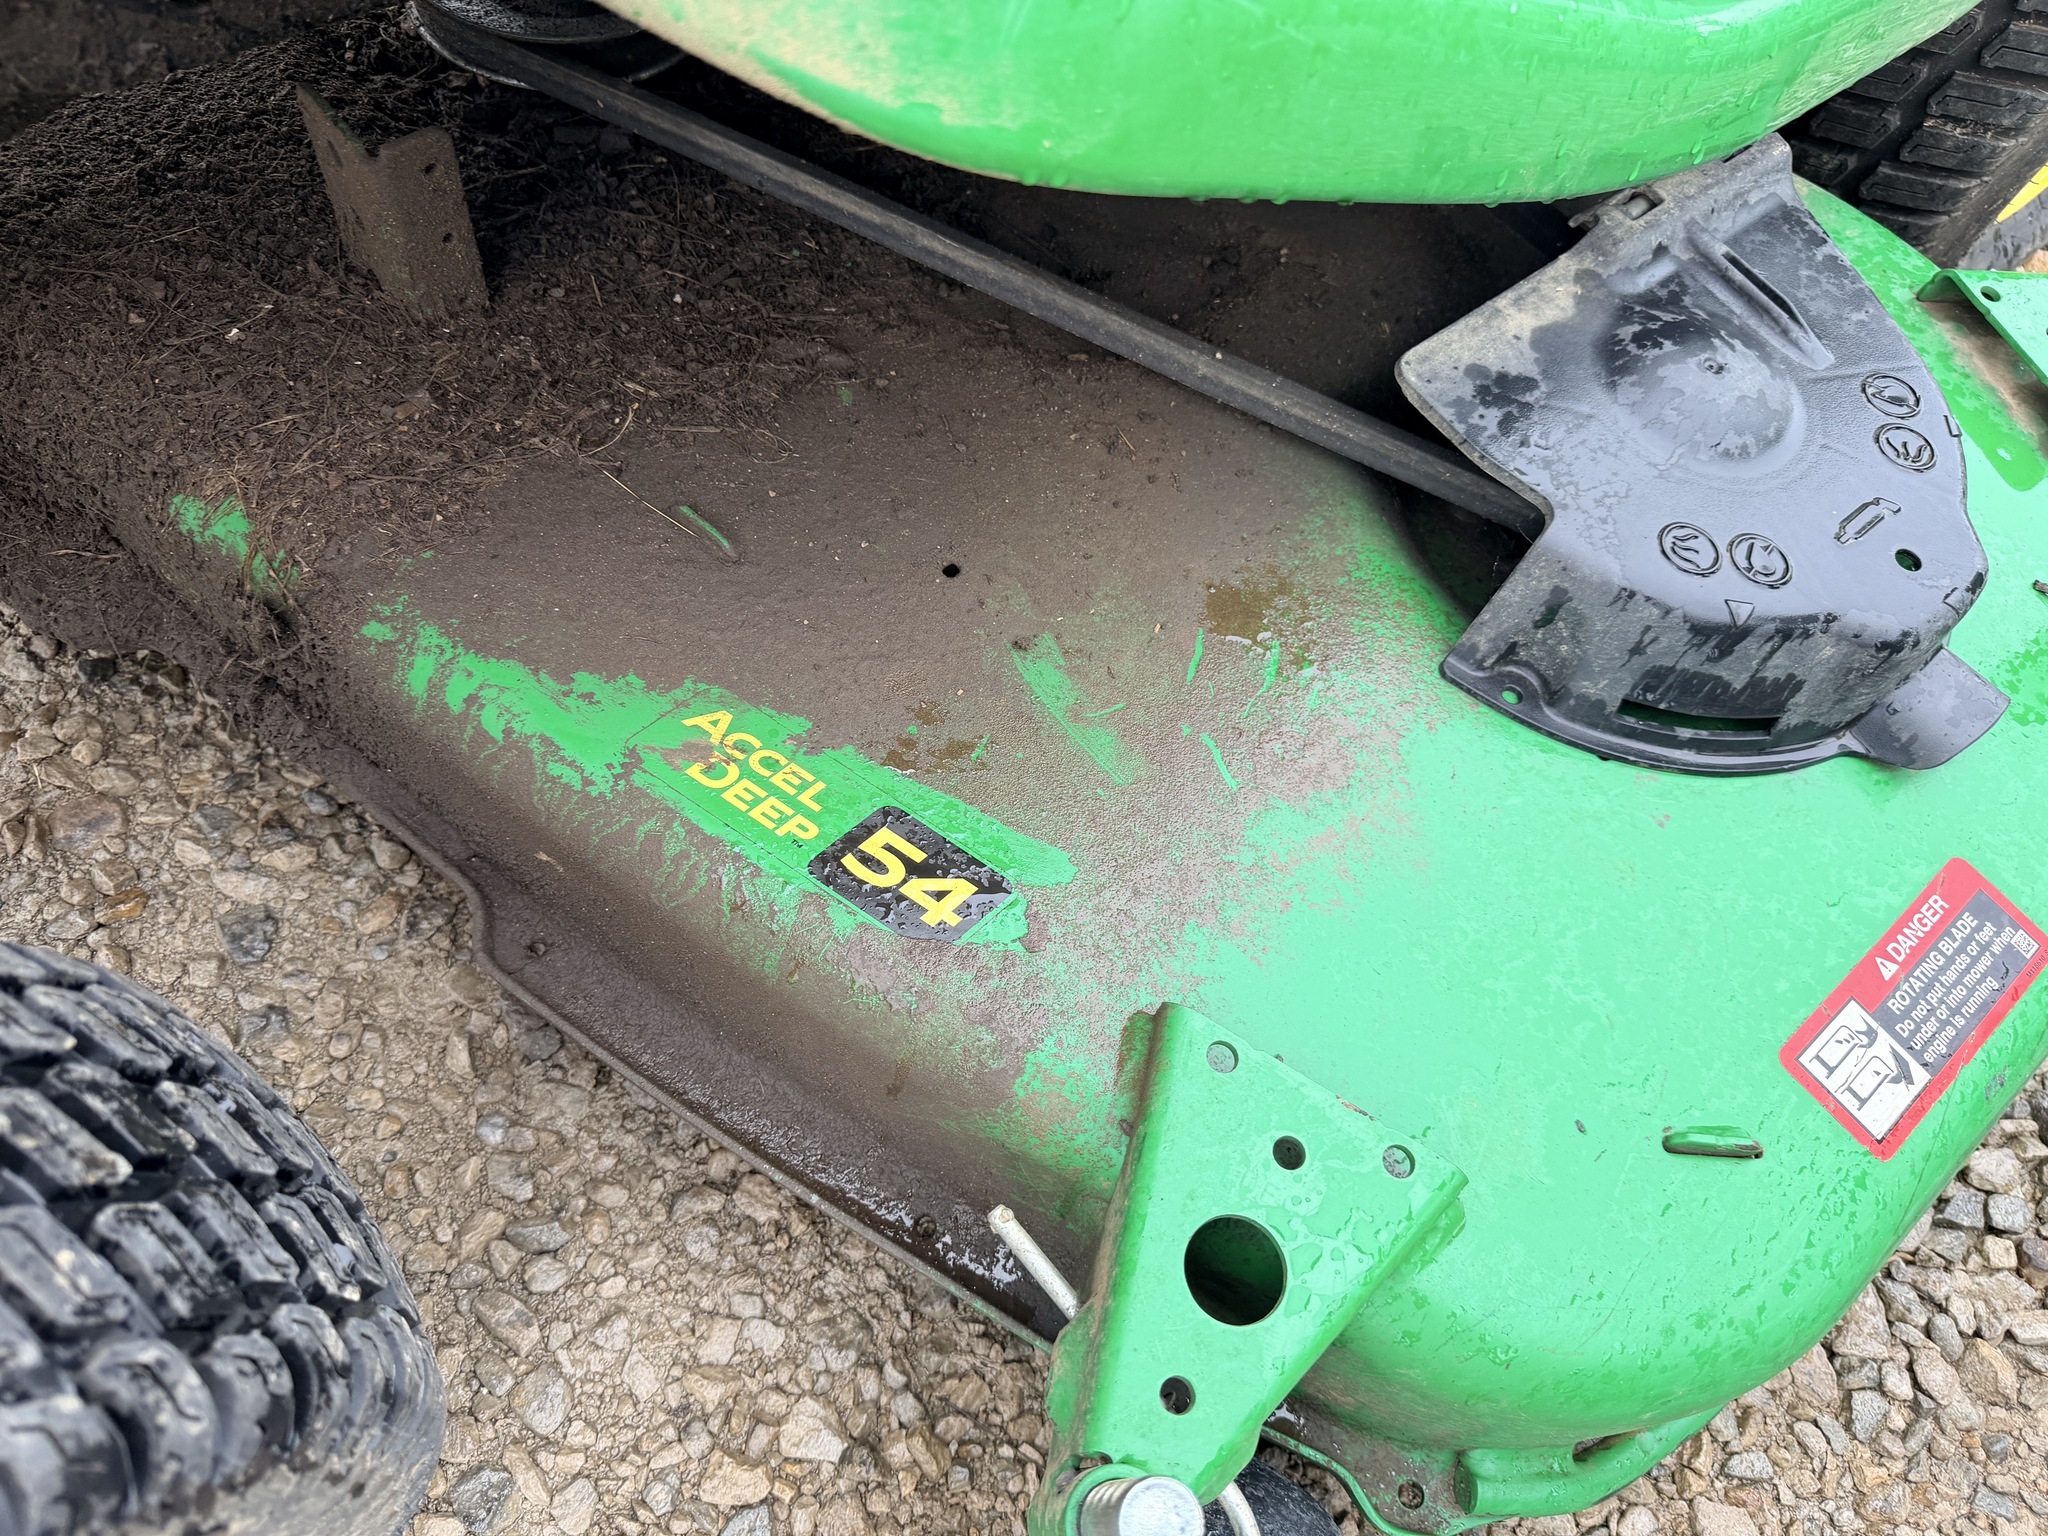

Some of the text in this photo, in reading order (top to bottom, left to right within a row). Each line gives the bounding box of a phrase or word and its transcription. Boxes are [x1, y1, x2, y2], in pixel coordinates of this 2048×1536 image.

[681, 710, 827, 812] ACCEL
[685, 750, 820, 840] DEEP
[840, 826, 979, 928] 54
[1886, 894, 1950, 963] DANGER
[1887, 912, 1979, 1015] ROTATING BLADE
[1894, 921, 1998, 1038] Do not put hands or feet
[1910, 925, 2016, 1051] under or into mower when
[1923, 975, 1999, 1062] engine is running
